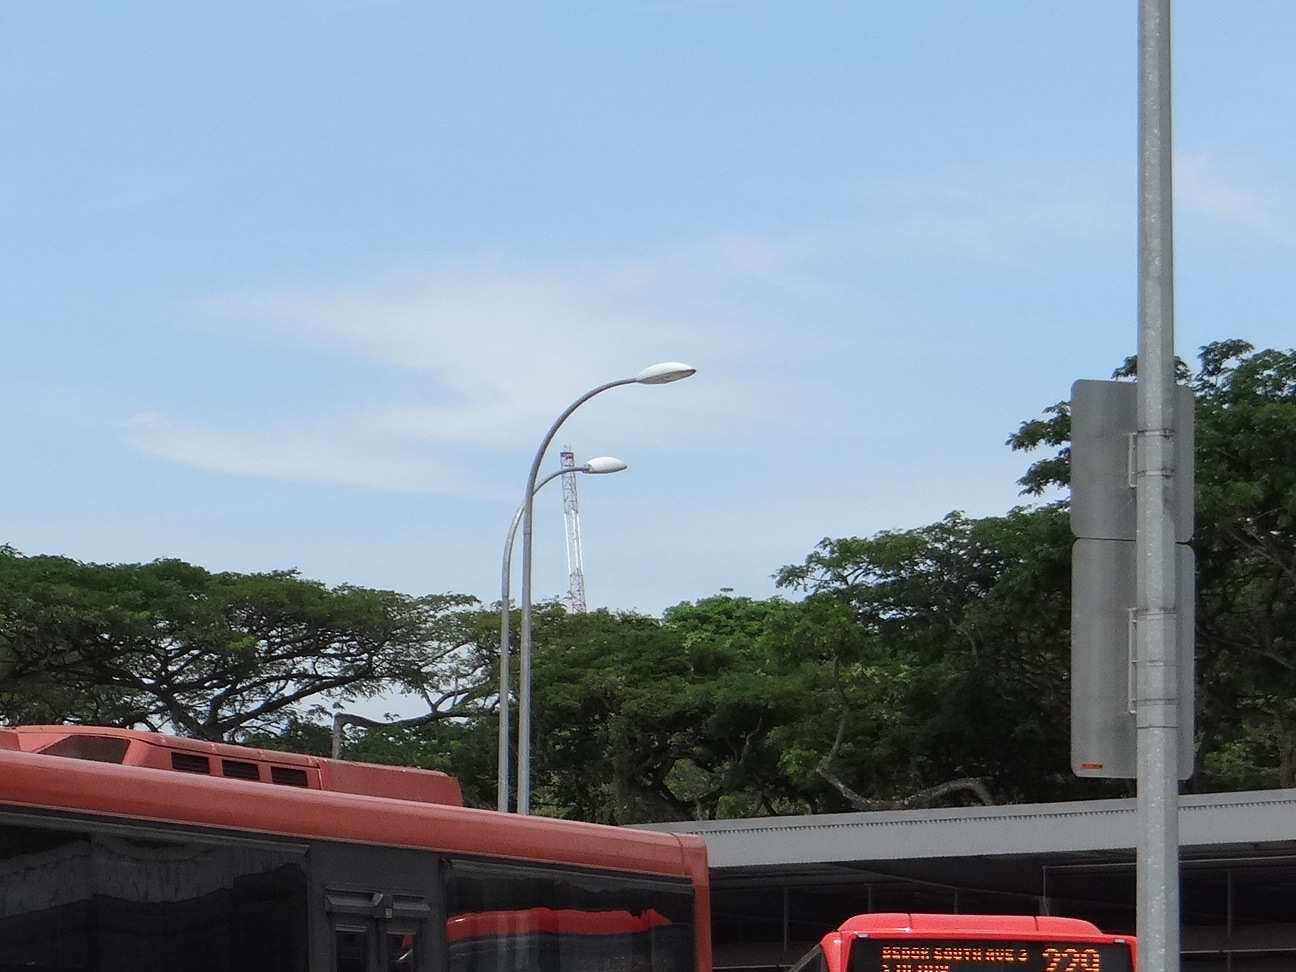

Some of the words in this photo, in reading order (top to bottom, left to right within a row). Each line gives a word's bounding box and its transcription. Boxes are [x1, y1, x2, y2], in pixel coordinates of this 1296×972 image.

[882, 946, 930, 960] BEDOK
[933, 947, 981, 961] SOUTH
[985, 948, 1014, 962] AVE
